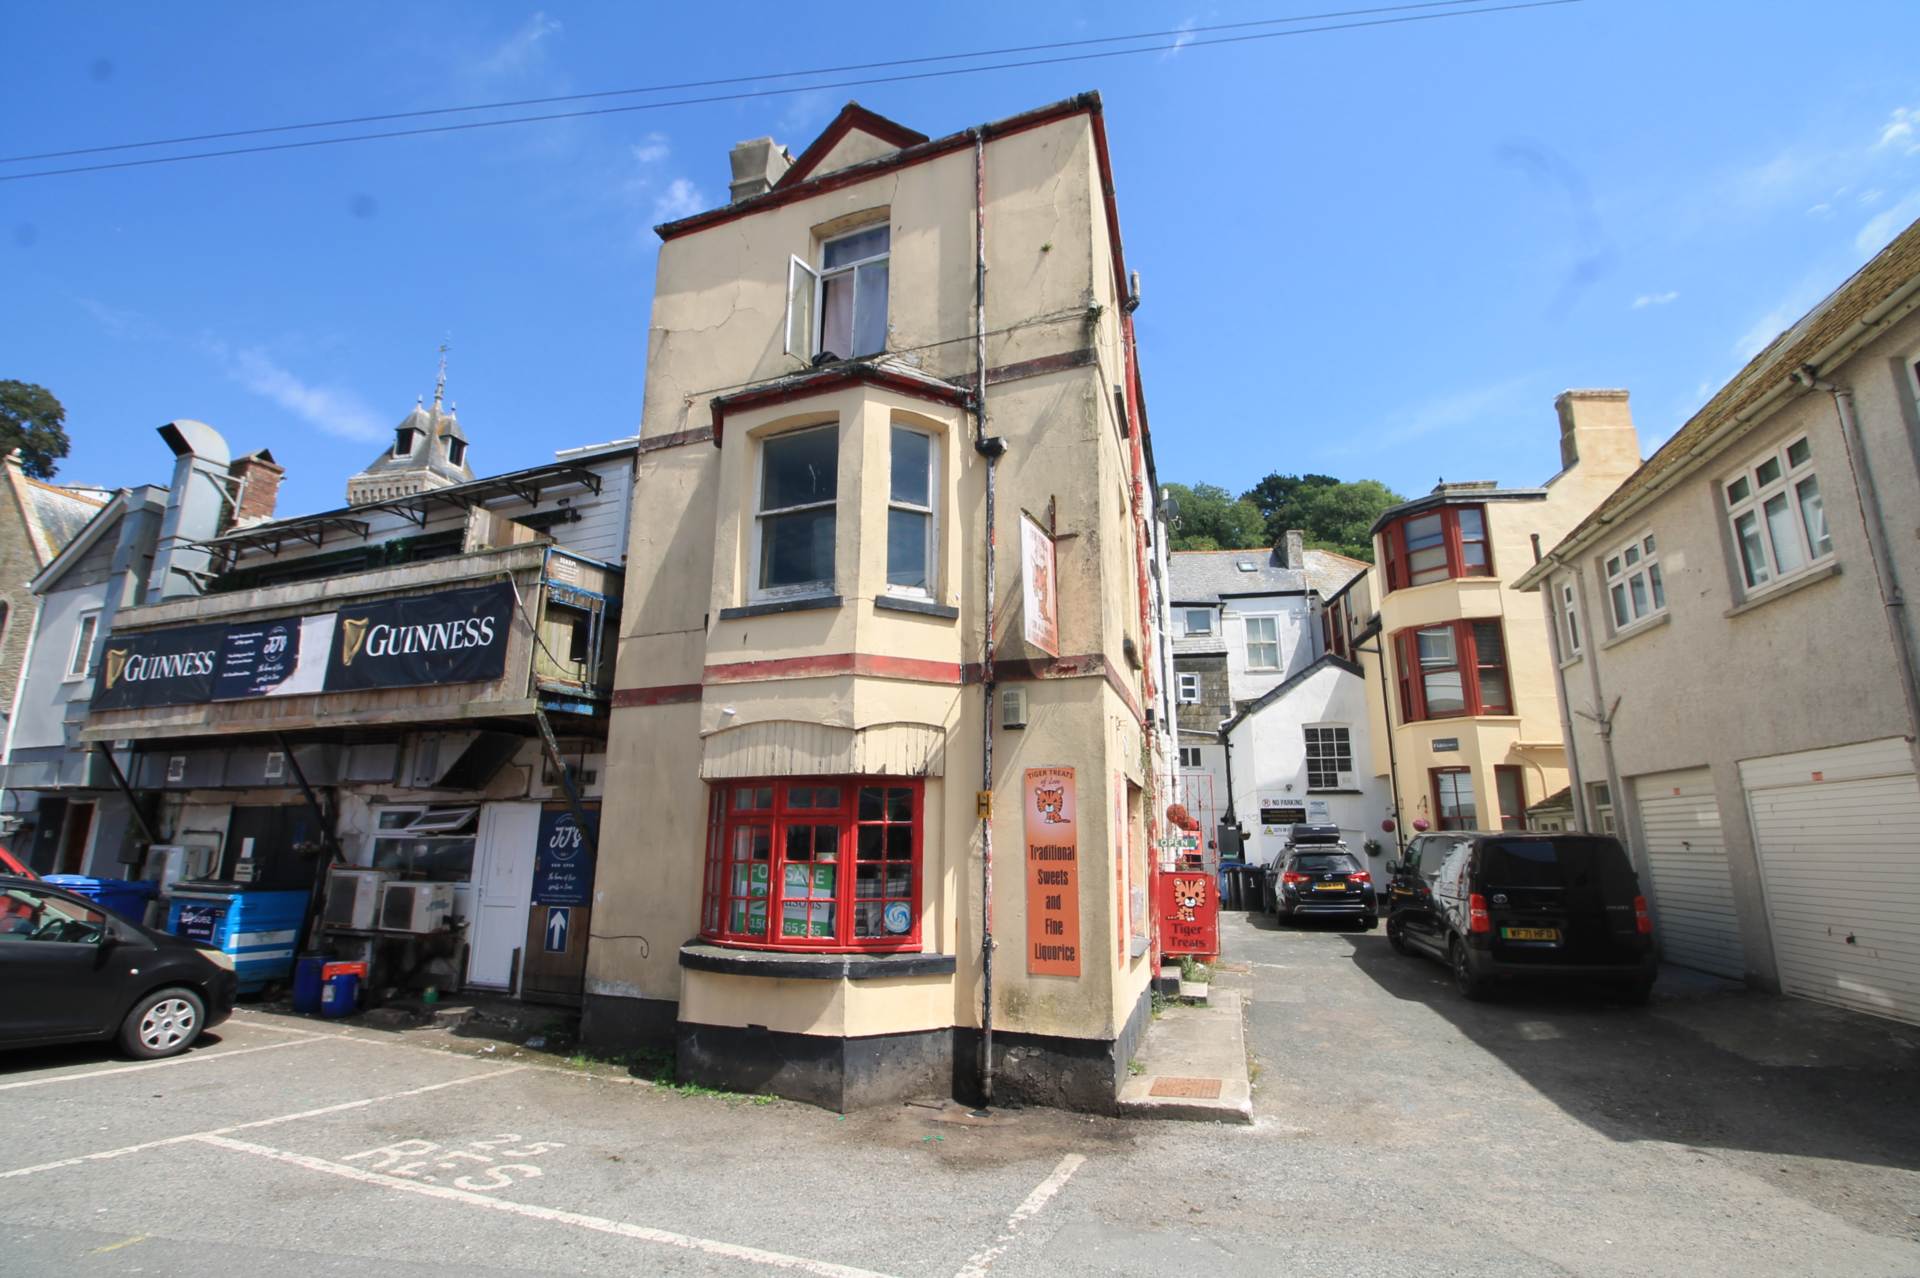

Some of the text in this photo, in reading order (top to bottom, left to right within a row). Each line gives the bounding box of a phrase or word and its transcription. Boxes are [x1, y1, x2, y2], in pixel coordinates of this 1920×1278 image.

[366, 616, 495, 657] GUINNESS
[124, 651, 216, 681] GUINNESS
[1028, 769, 1073, 779] TIGER TREATS
[1160, 839, 1189, 848] OPEN
[1030, 844, 1075, 861] Traditional
[1037, 868, 1069, 885] Sweets
[1046, 894, 1061, 910] and
[1045, 918, 1064, 935] Fine
[1171, 922, 1203, 936] Tiger
[1169, 936, 1207, 948] Treats
[1035, 943, 1075, 961] Liquorice
